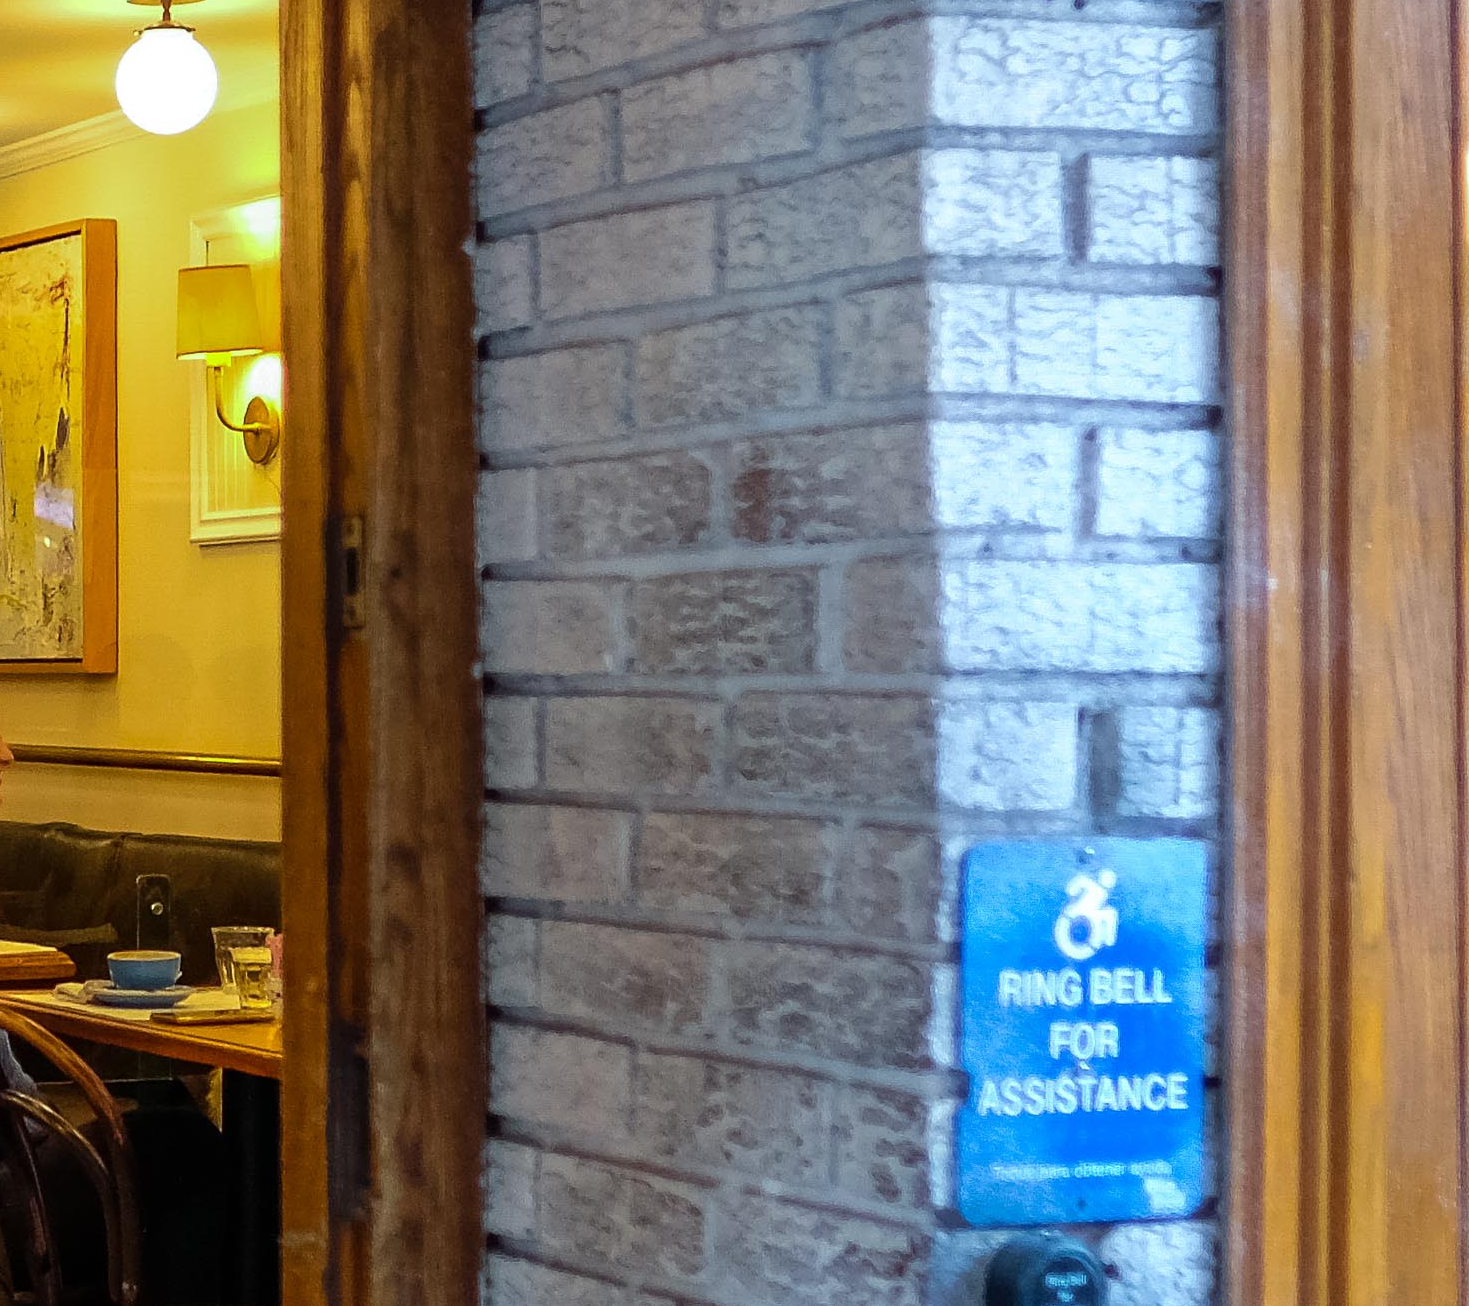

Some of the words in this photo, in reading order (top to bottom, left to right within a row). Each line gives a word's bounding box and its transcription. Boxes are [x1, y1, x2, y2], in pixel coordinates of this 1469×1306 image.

[997, 967, 1083, 1009] RING
[1089, 966, 1173, 1006] BELL
[1048, 1020, 1120, 1060] FOR
[977, 1071, 1190, 1117] ASSISTANCE
